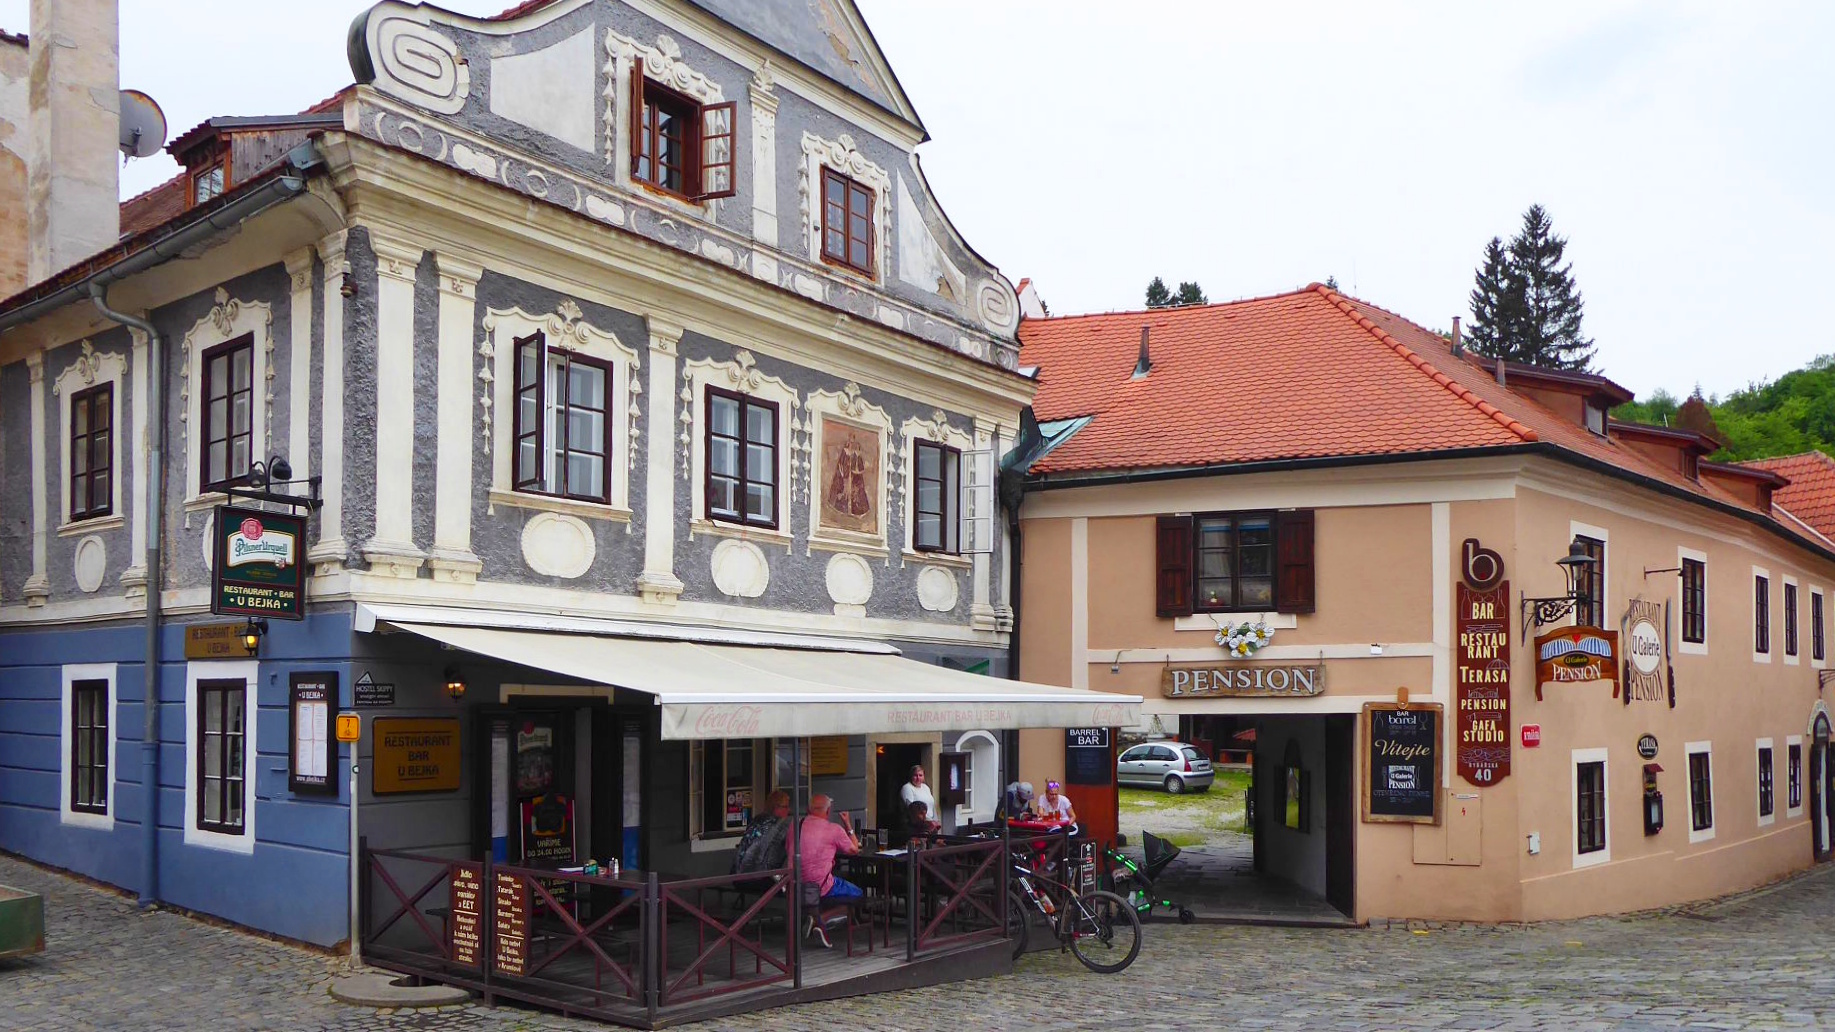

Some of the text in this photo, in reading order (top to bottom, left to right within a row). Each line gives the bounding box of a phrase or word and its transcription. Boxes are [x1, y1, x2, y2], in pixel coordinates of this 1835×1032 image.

[235, 538, 288, 556] Pilsner Urquell
[224, 585, 294, 599] RESTAURANT BAR
[237, 596, 281, 608] U BEJKA
[1472, 602, 1494, 620] BAR
[1461, 633, 1507, 647] RESTAU
[1632, 635, 1660, 657] U Galerie
[1467, 645, 1499, 659] RANT
[1460, 666, 1508, 683] TERASA
[1552, 660, 1601, 681] PENSION
[1172, 669, 1316, 695] PENSION
[1630, 668, 1664, 701] PENSION
[1461, 698, 1507, 710] PENSION
[888, 709, 1012, 723] RESTAURANT BAR U BEJKA
[1388, 714, 1417, 725] barel
[1472, 720, 1496, 731] GAFA
[385, 735, 451, 748] RESTAURANT
[1078, 736, 1100, 745] BAR
[1463, 730, 1505, 743] STUDIO
[408, 750, 430, 762] BAR
[1374, 740, 1431, 761] Vítejte
[398, 765, 440, 777] U BEJKA
[1475, 768, 1492, 782] 40
[1388, 779, 1416, 789] PENSION
[462, 900, 474, 910] EET
